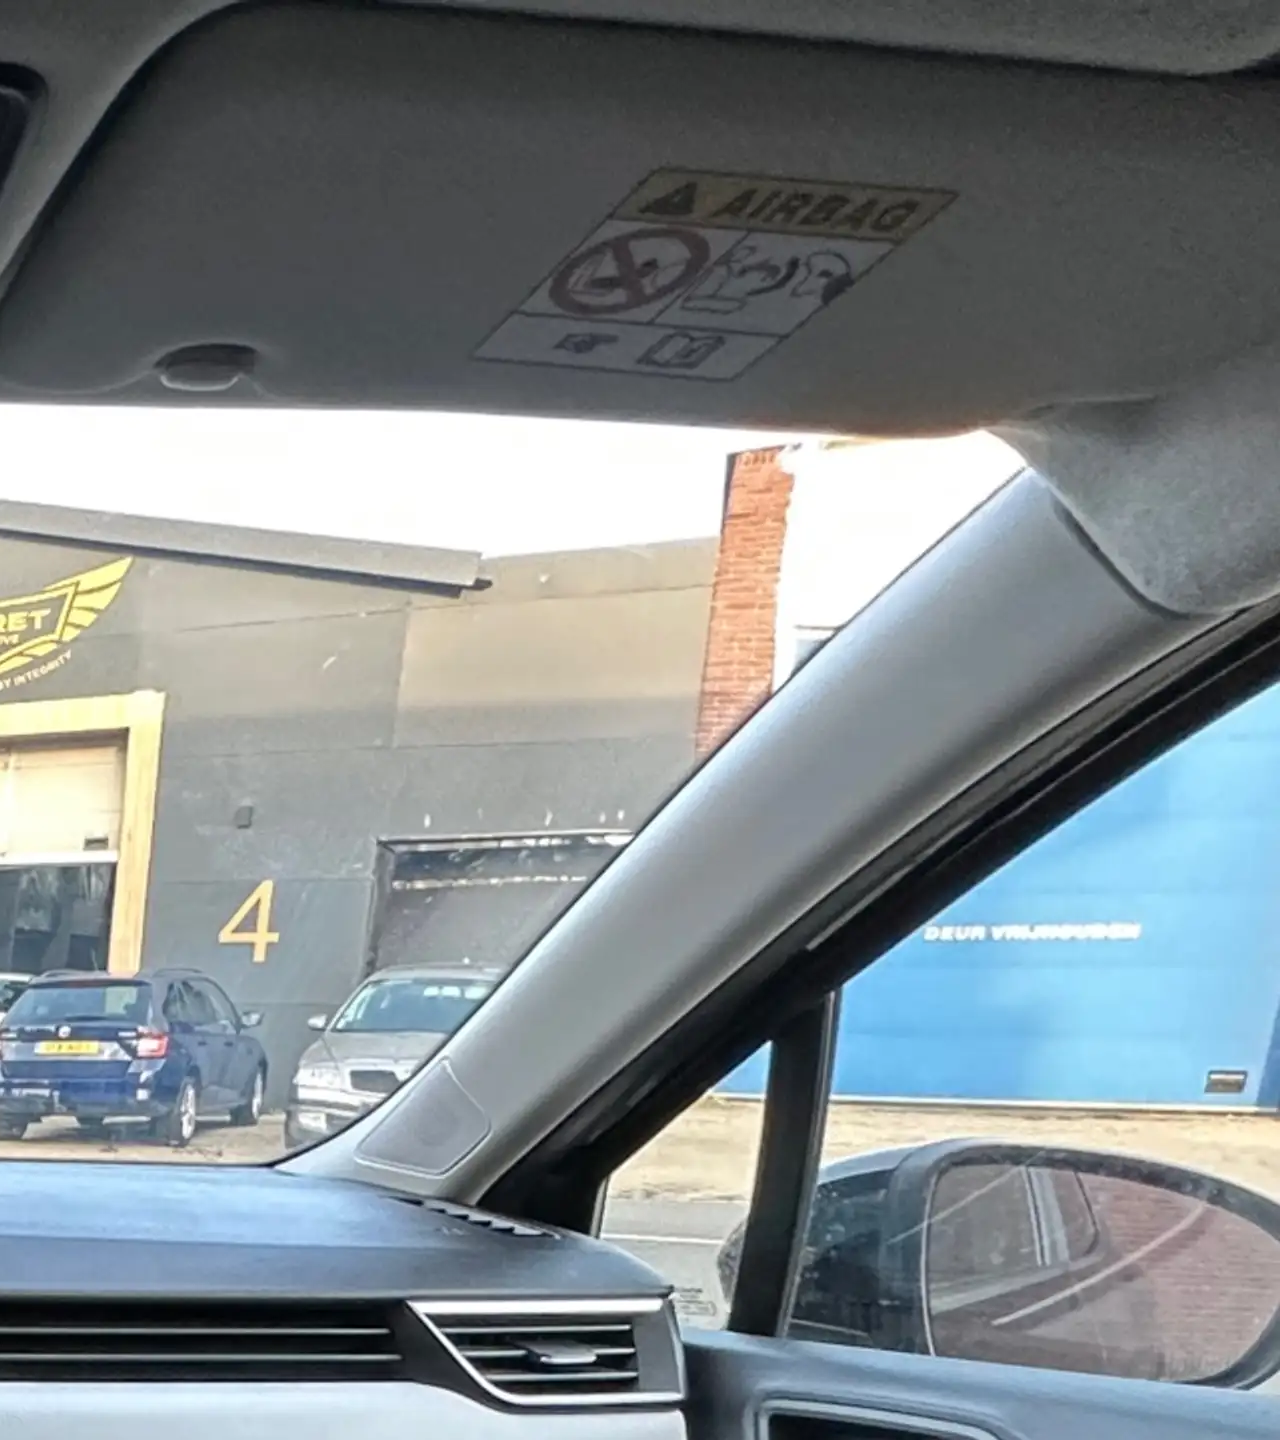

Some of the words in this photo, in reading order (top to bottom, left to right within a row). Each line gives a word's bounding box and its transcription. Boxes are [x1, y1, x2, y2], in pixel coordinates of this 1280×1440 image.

[712, 188, 919, 232] AIRBAG
[218, 879, 279, 963] 4
[924, 925, 986, 941] DEUR
